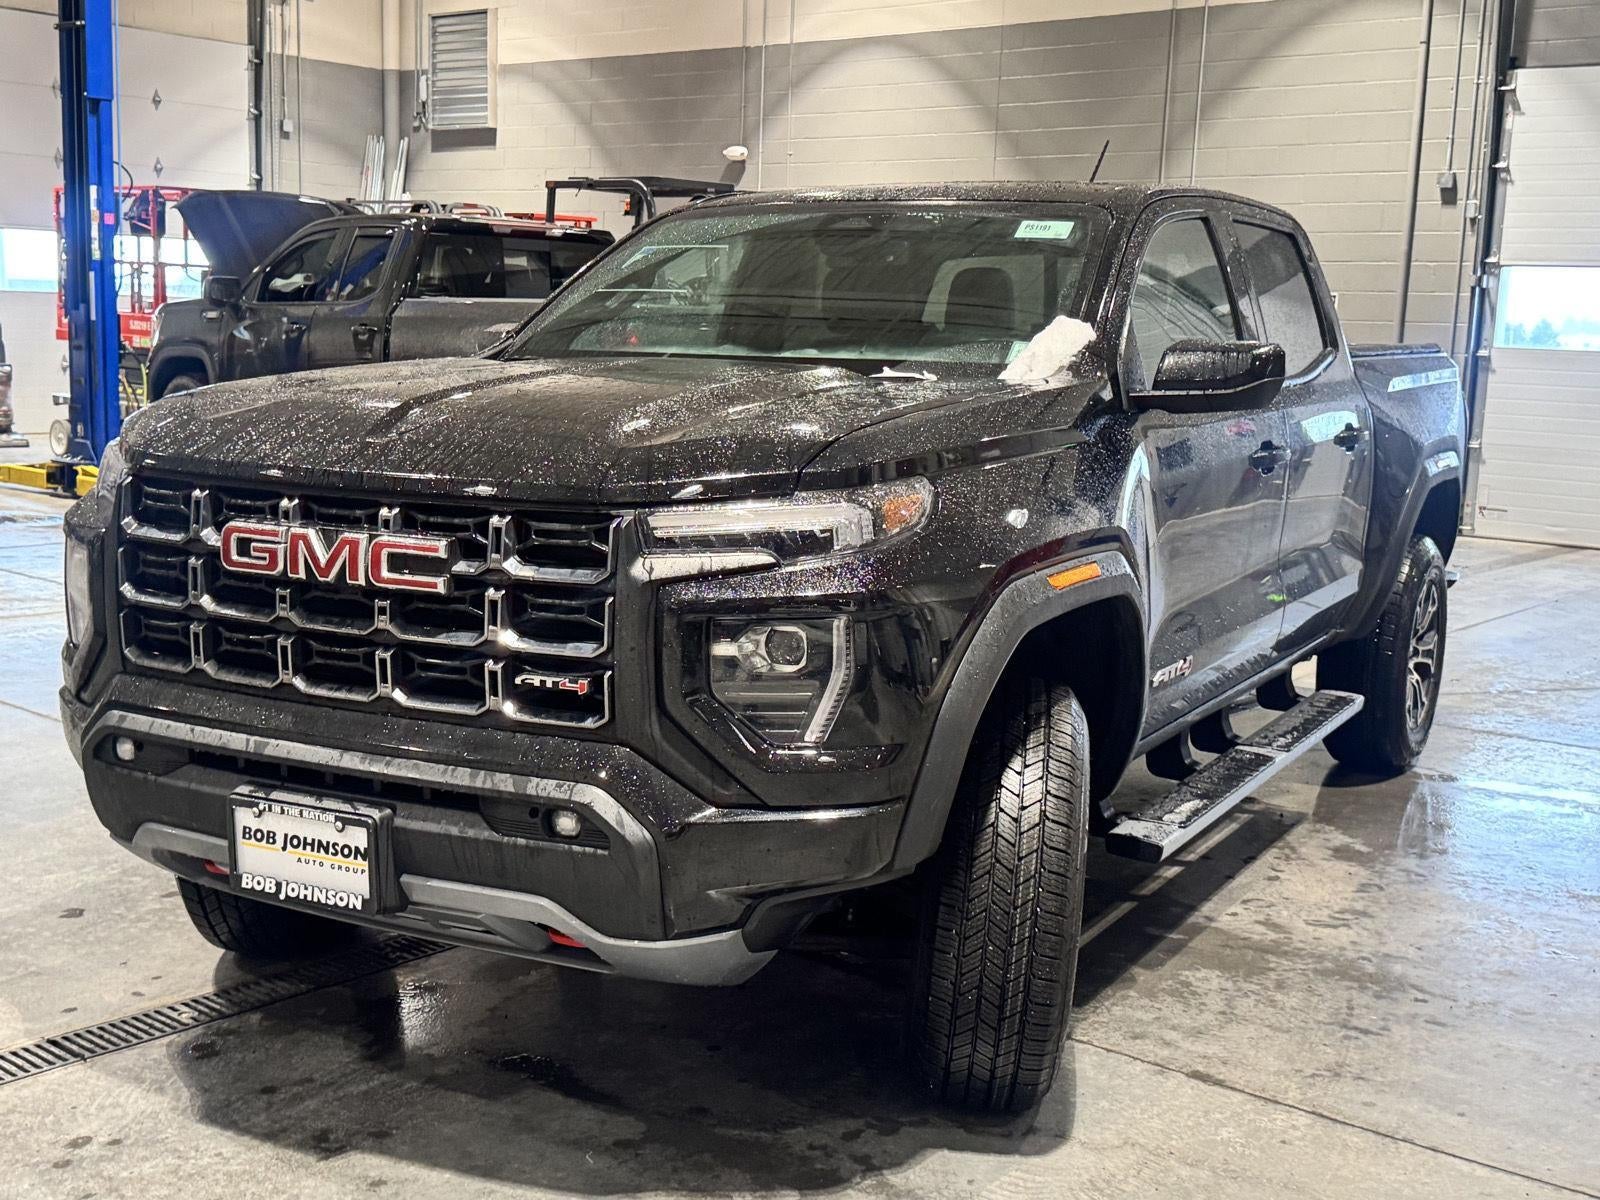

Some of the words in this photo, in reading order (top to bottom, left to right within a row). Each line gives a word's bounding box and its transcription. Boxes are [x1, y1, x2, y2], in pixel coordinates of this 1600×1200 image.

[220, 521, 449, 594] GMC
[514, 673, 589, 695] AT4
[1152, 654, 1194, 688] AT4
[271, 803, 282, 814] IN
[283, 805, 301, 817] THE
[303, 809, 336, 823] NATION
[241, 825, 277, 845] BOB
[281, 832, 368, 862] JOHNSON
[296, 856, 325, 868] AUTO
[330, 863, 366, 876] GROUP
[241, 872, 277, 894] BOB
[279, 879, 363, 911] JOHNSON
